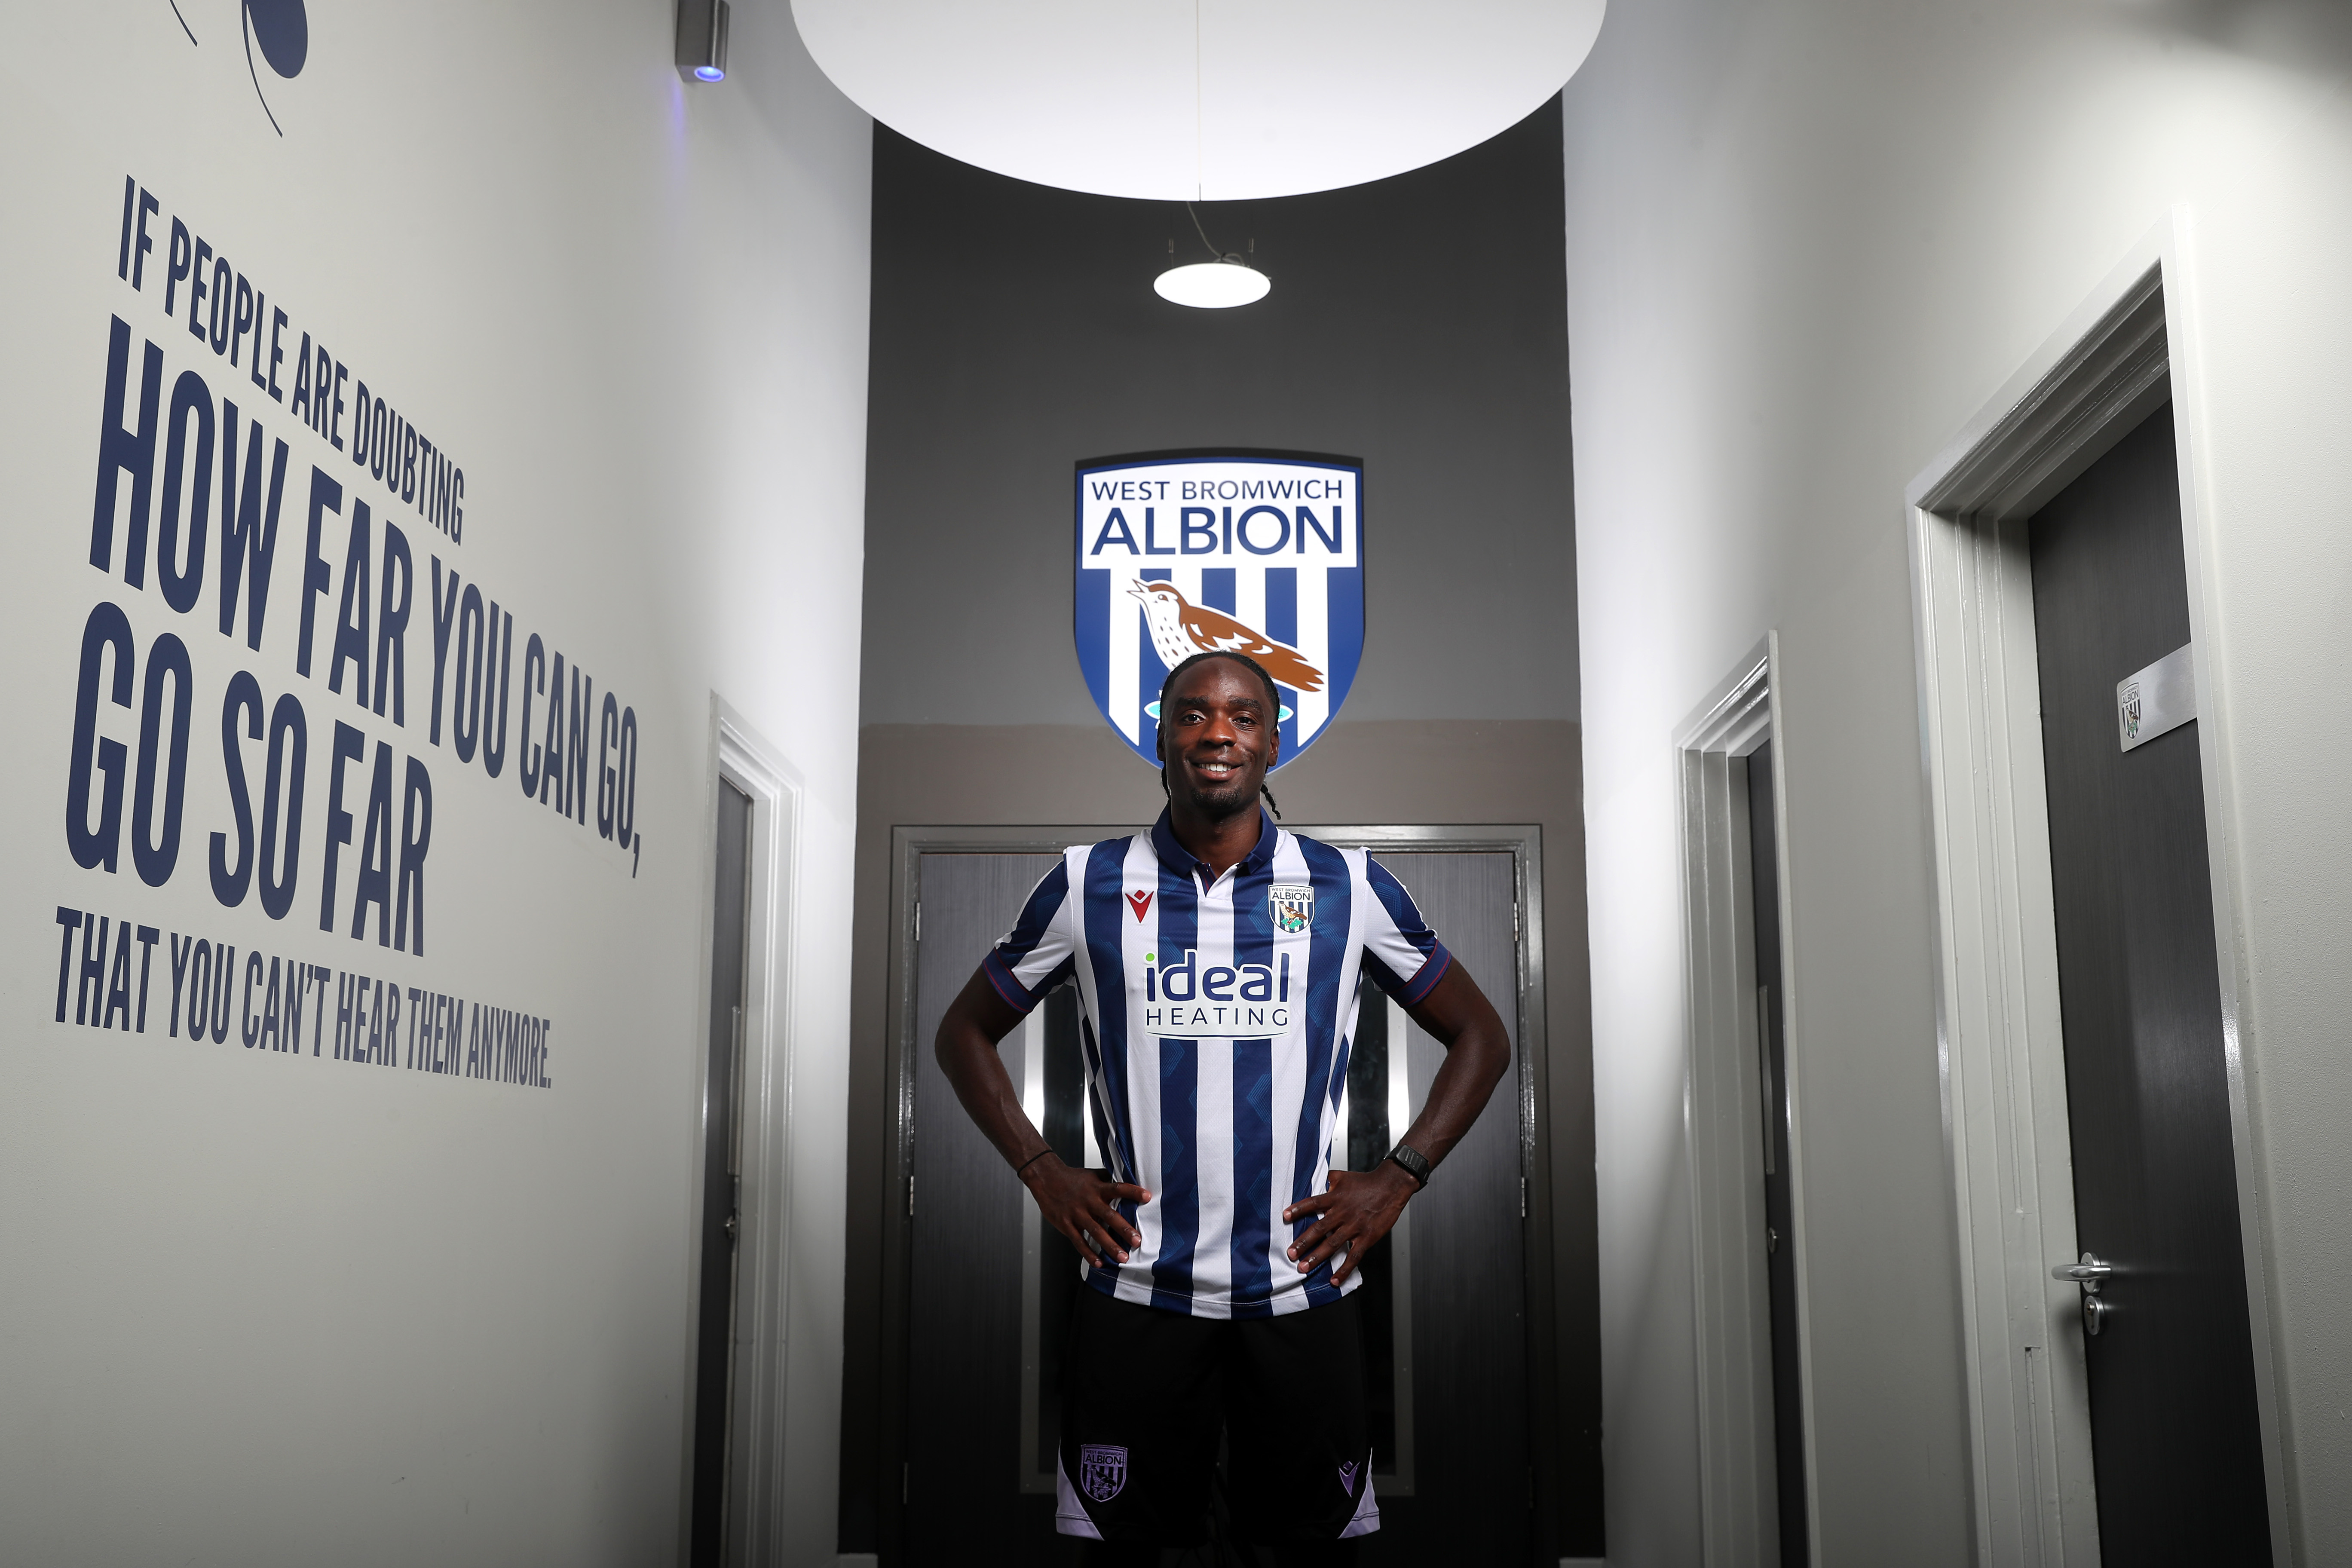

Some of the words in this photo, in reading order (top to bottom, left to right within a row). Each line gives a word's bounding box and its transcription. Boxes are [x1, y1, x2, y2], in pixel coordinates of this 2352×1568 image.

[119, 175, 159, 292] IF
[165, 215, 288, 404] PEOPLE
[292, 331, 348, 452] ARE
[353, 380, 464, 545] DOUBTING
[1092, 481, 1170, 500] WEST
[1182, 480, 1342, 499] BROMWICH
[1090, 505, 1342, 555] ALBION
[89, 313, 289, 652] HOW
[297, 465, 412, 728] FAR
[430, 554, 512, 778] YOU
[520, 633, 591, 826] CAN
[598, 692, 640, 879] GO,
[2122, 689, 2139, 704] ALBION
[66, 602, 192, 887] GO
[209, 671, 307, 920] SO
[320, 720, 432, 957] FAR
[1272, 892, 1310, 900] ALBION
[55, 906, 159, 1033] THAT
[170, 932, 235, 1044] YOU
[242, 951, 331, 1057] CAN'T
[334, 972, 400, 1067] HEAR
[408, 987, 463, 1076] THEM
[466, 1003, 552, 1088] ANYMORE.
[1146, 951, 1289, 1002] ideal
[1146, 1008, 1288, 1027] HEATING
[1085, 1454, 1121, 1465] ALBION
